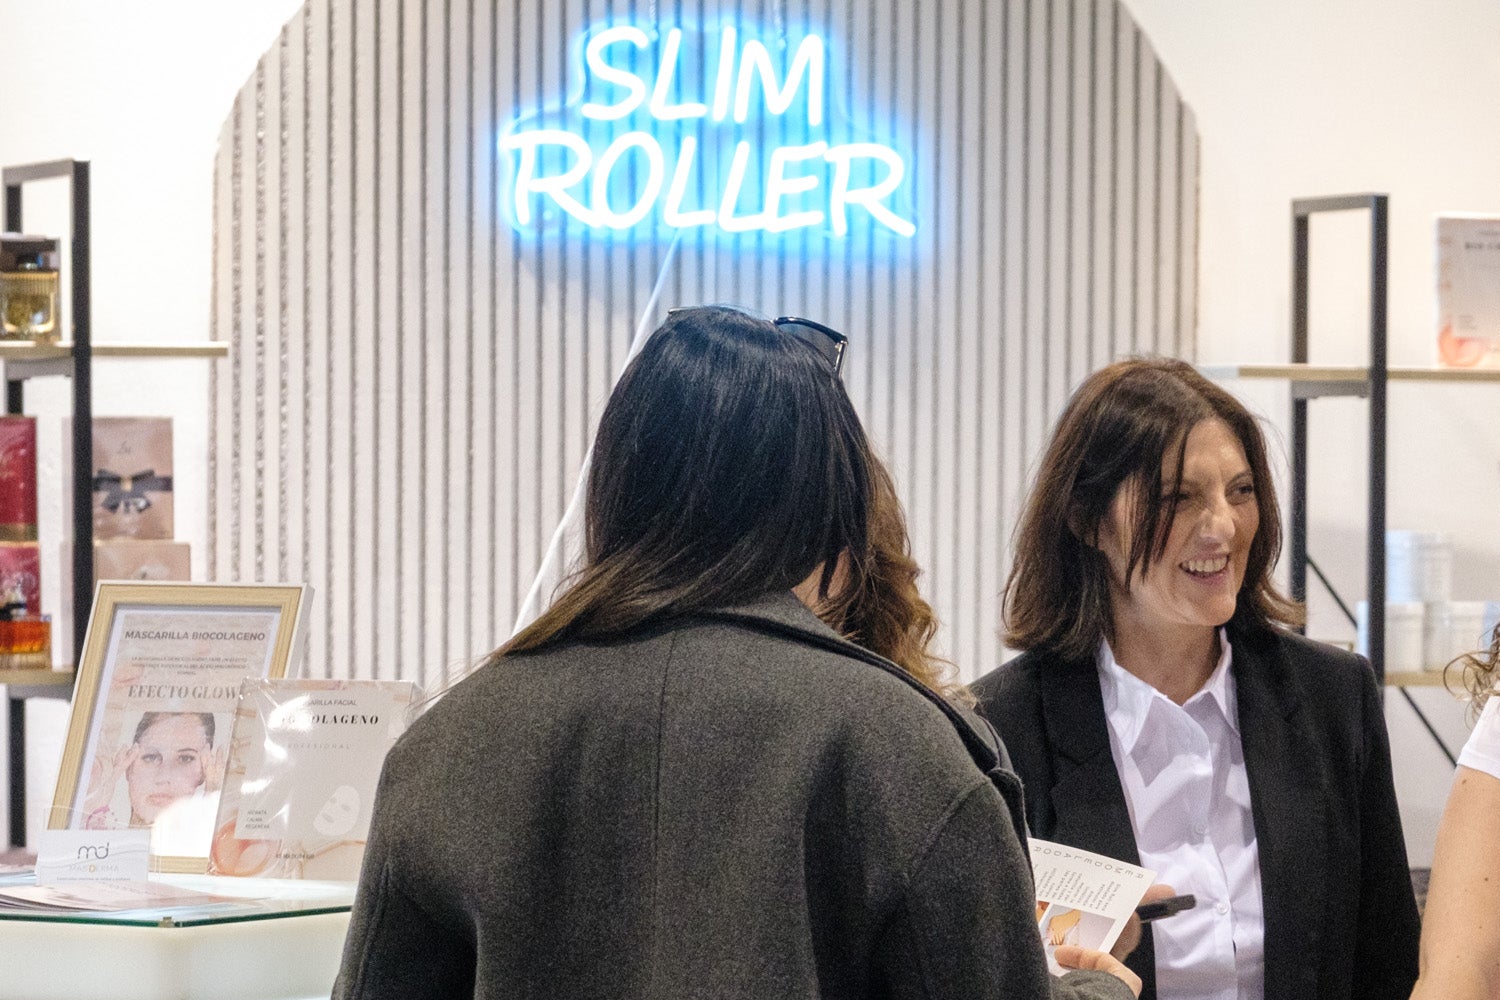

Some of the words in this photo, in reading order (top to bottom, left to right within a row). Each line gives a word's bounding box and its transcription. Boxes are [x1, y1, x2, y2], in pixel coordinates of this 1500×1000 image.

[581, 25, 824, 126] SLIM
[499, 129, 916, 237] ROLLER
[124, 631, 189, 640] MASCARILLA
[191, 631, 266, 641] BIOCOLAGENO
[128, 684, 189, 699] EFECTO
[191, 685, 238, 699] GLOW
[311, 714, 380, 725] OLAGENO
[1033, 846, 1145, 879] REMODELADOR
